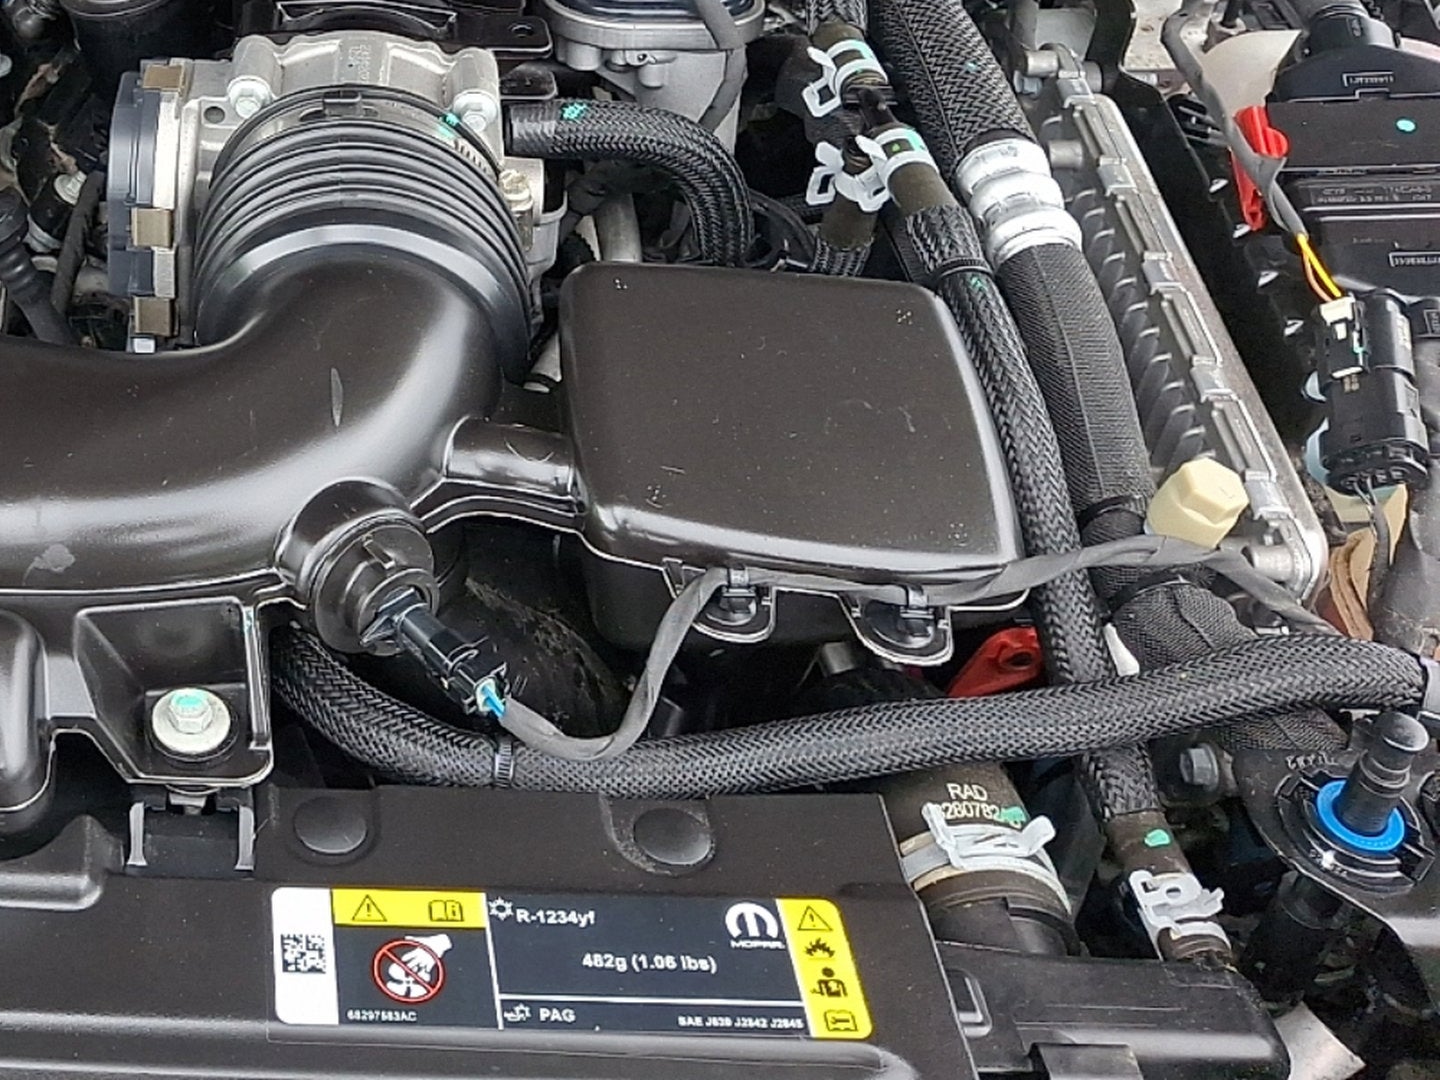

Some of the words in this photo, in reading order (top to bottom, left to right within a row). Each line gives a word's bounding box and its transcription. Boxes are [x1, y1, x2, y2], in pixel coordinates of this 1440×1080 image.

[946, 782, 988, 801] RAD
[516, 908, 596, 928] R-1234yf
[680, 955, 717, 975] lbs)
[539, 1007, 576, 1023] PAG
[677, 1015, 703, 1027] SAE
